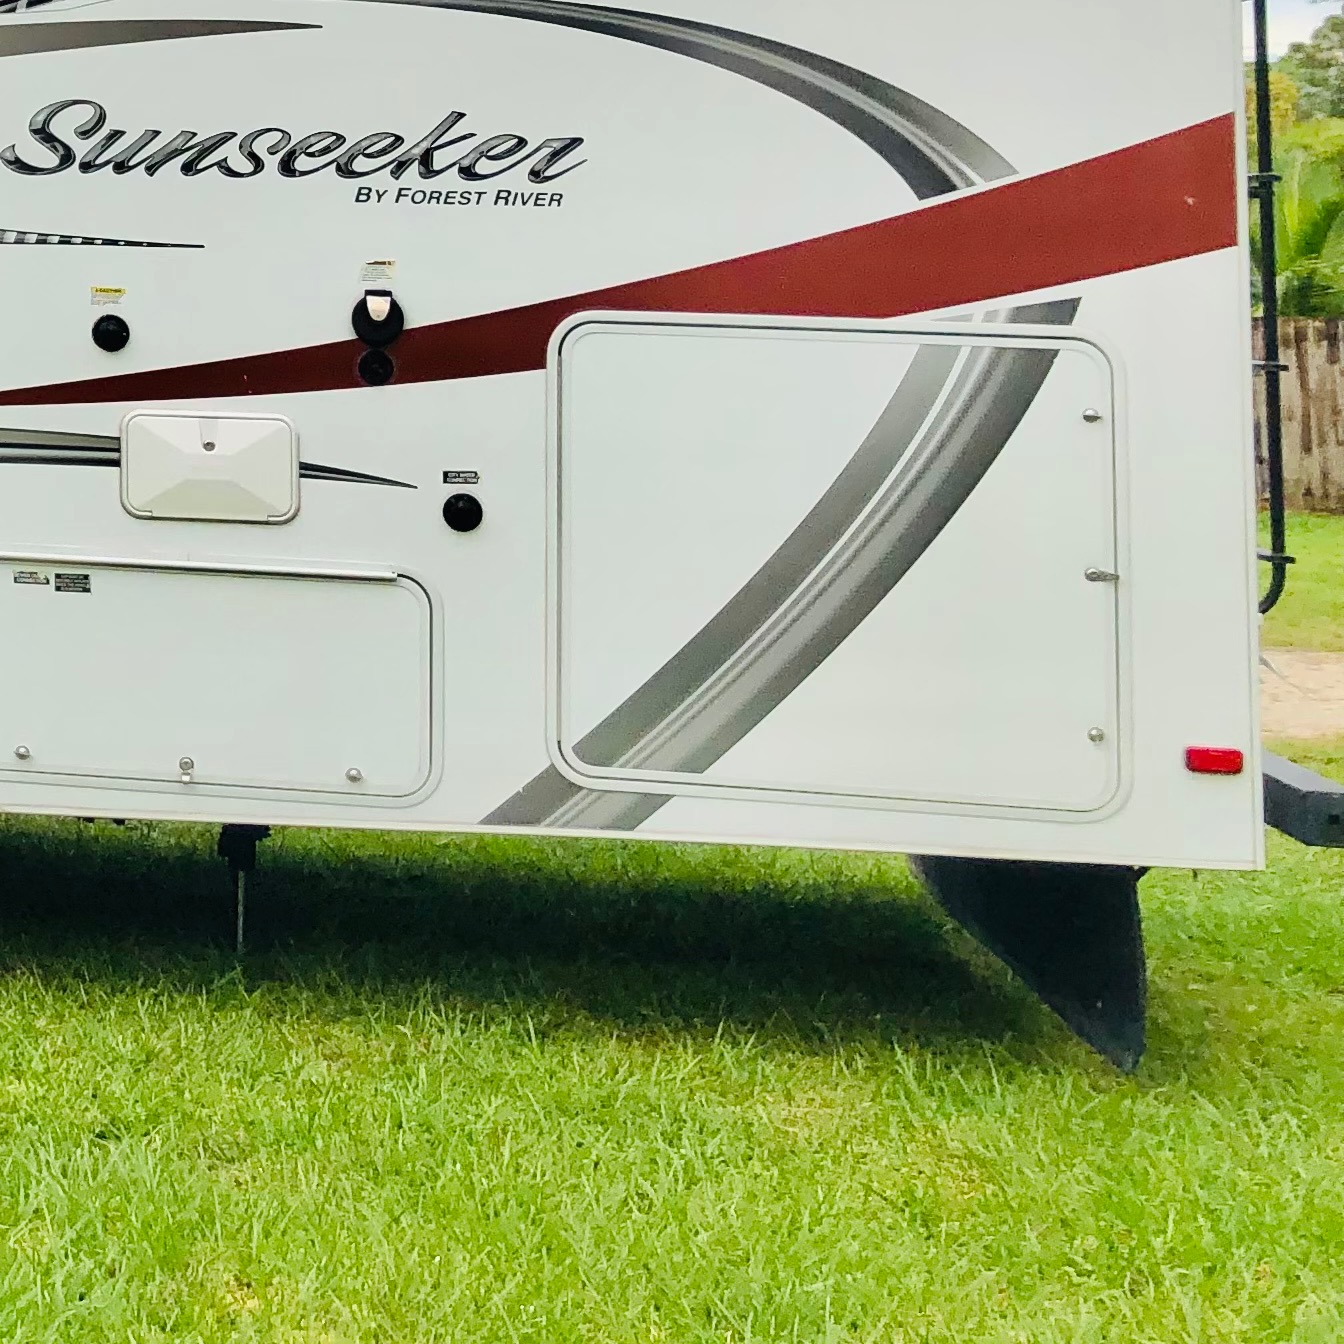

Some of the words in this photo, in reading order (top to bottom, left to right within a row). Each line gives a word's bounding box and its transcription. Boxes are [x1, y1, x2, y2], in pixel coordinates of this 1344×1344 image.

[0, 99, 589, 184] Sunseeker
[395, 187, 487, 206] FOREST
[494, 189, 564, 208] RIVER
